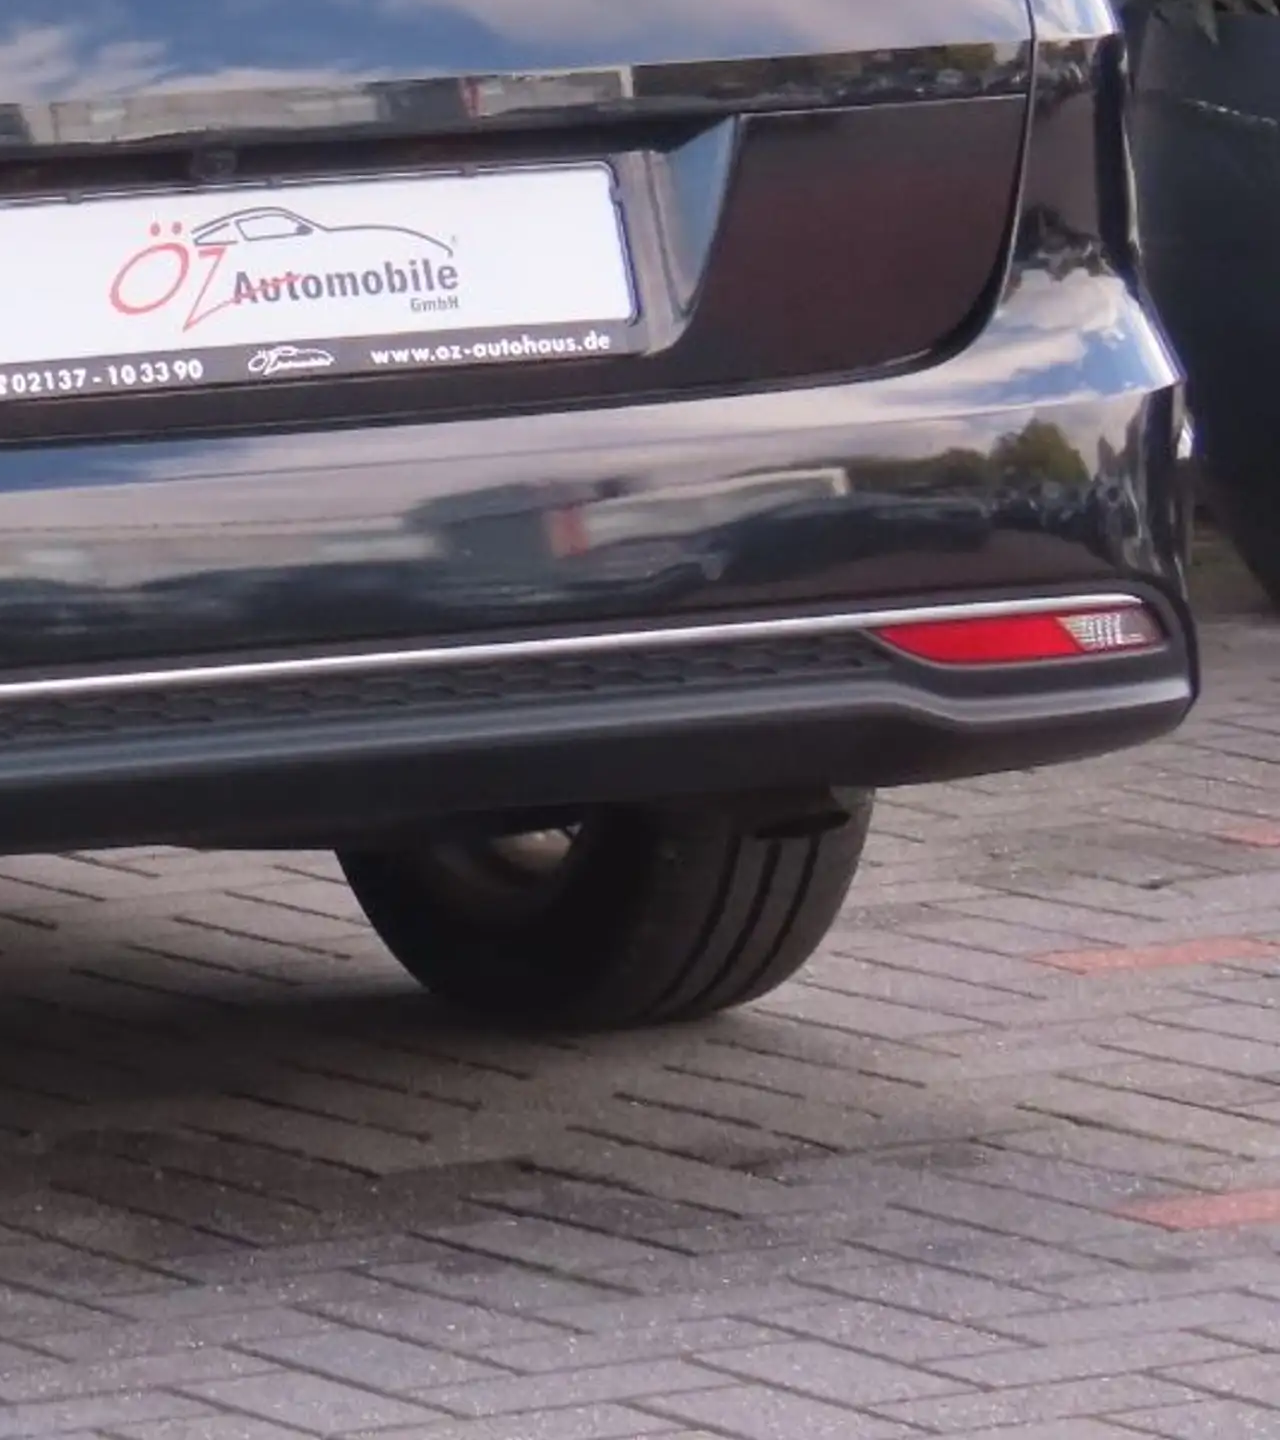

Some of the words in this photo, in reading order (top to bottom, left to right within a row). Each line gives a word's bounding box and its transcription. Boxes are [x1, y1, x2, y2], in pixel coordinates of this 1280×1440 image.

[232, 258, 459, 304] Automobile
[409, 295, 460, 314] GmbH
[369, 329, 613, 365] www.oz-autohaus.de
